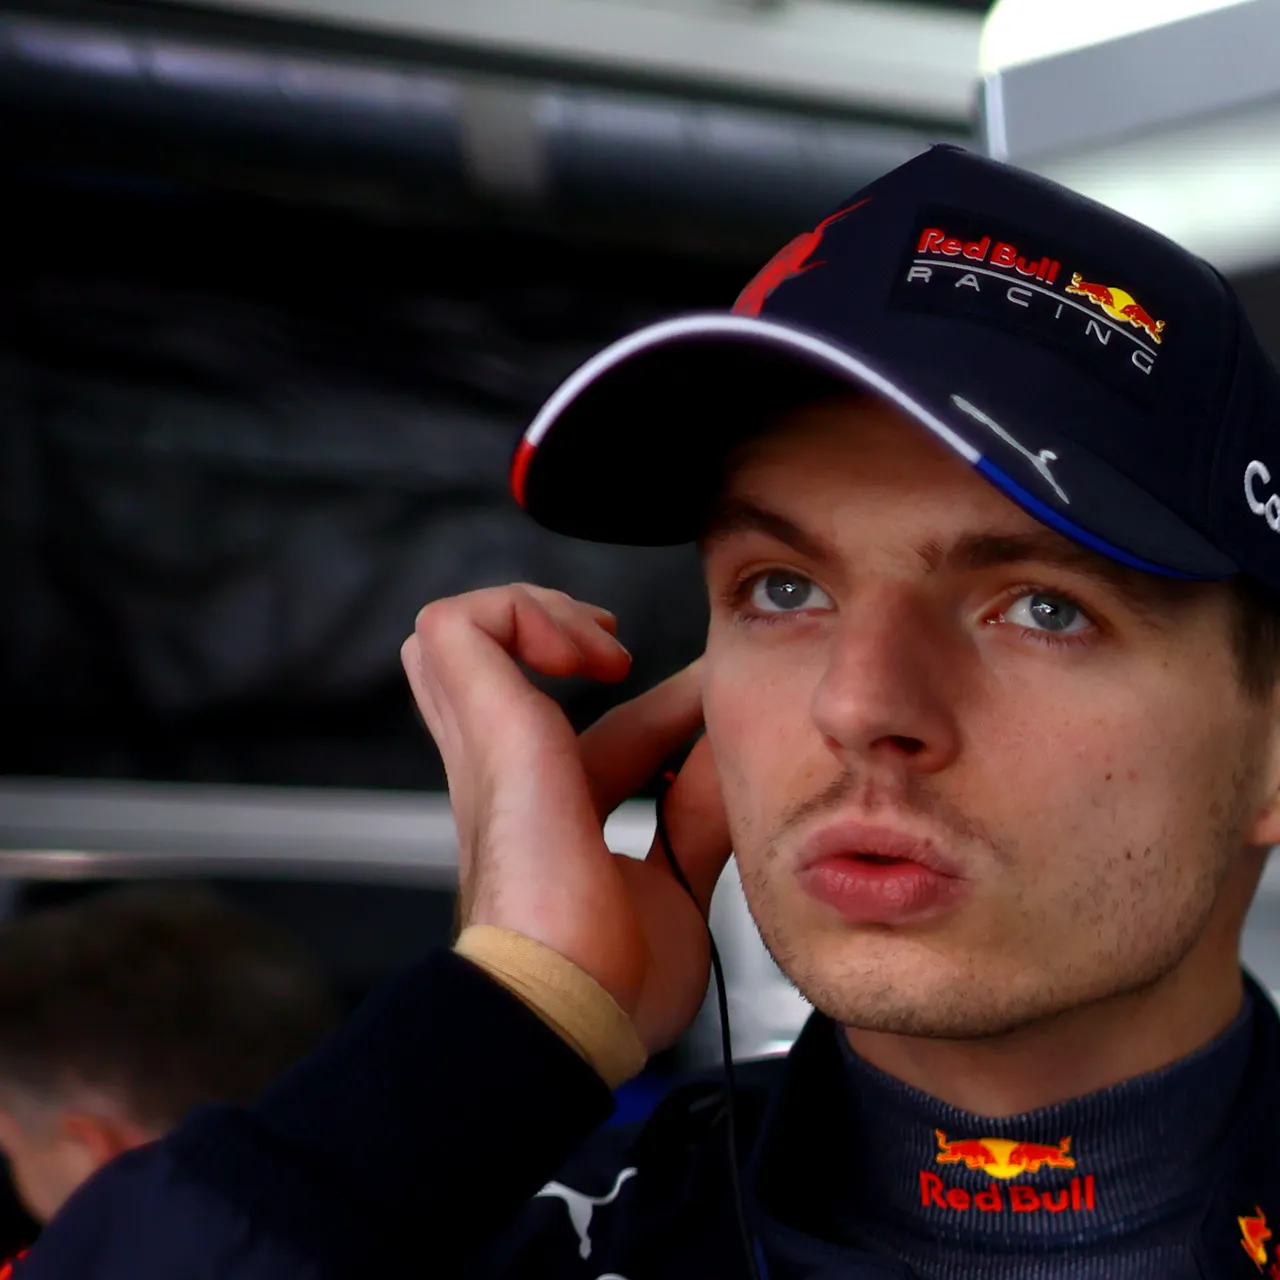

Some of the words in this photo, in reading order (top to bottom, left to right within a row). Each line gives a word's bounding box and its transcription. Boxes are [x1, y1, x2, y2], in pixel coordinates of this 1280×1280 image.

[917, 228, 991, 261] Red
[990, 241, 1061, 285] Bull
[907, 266, 1155, 376] RACING
[919, 1170, 1003, 1212] Red
[1009, 1174, 1096, 1213] Bull
